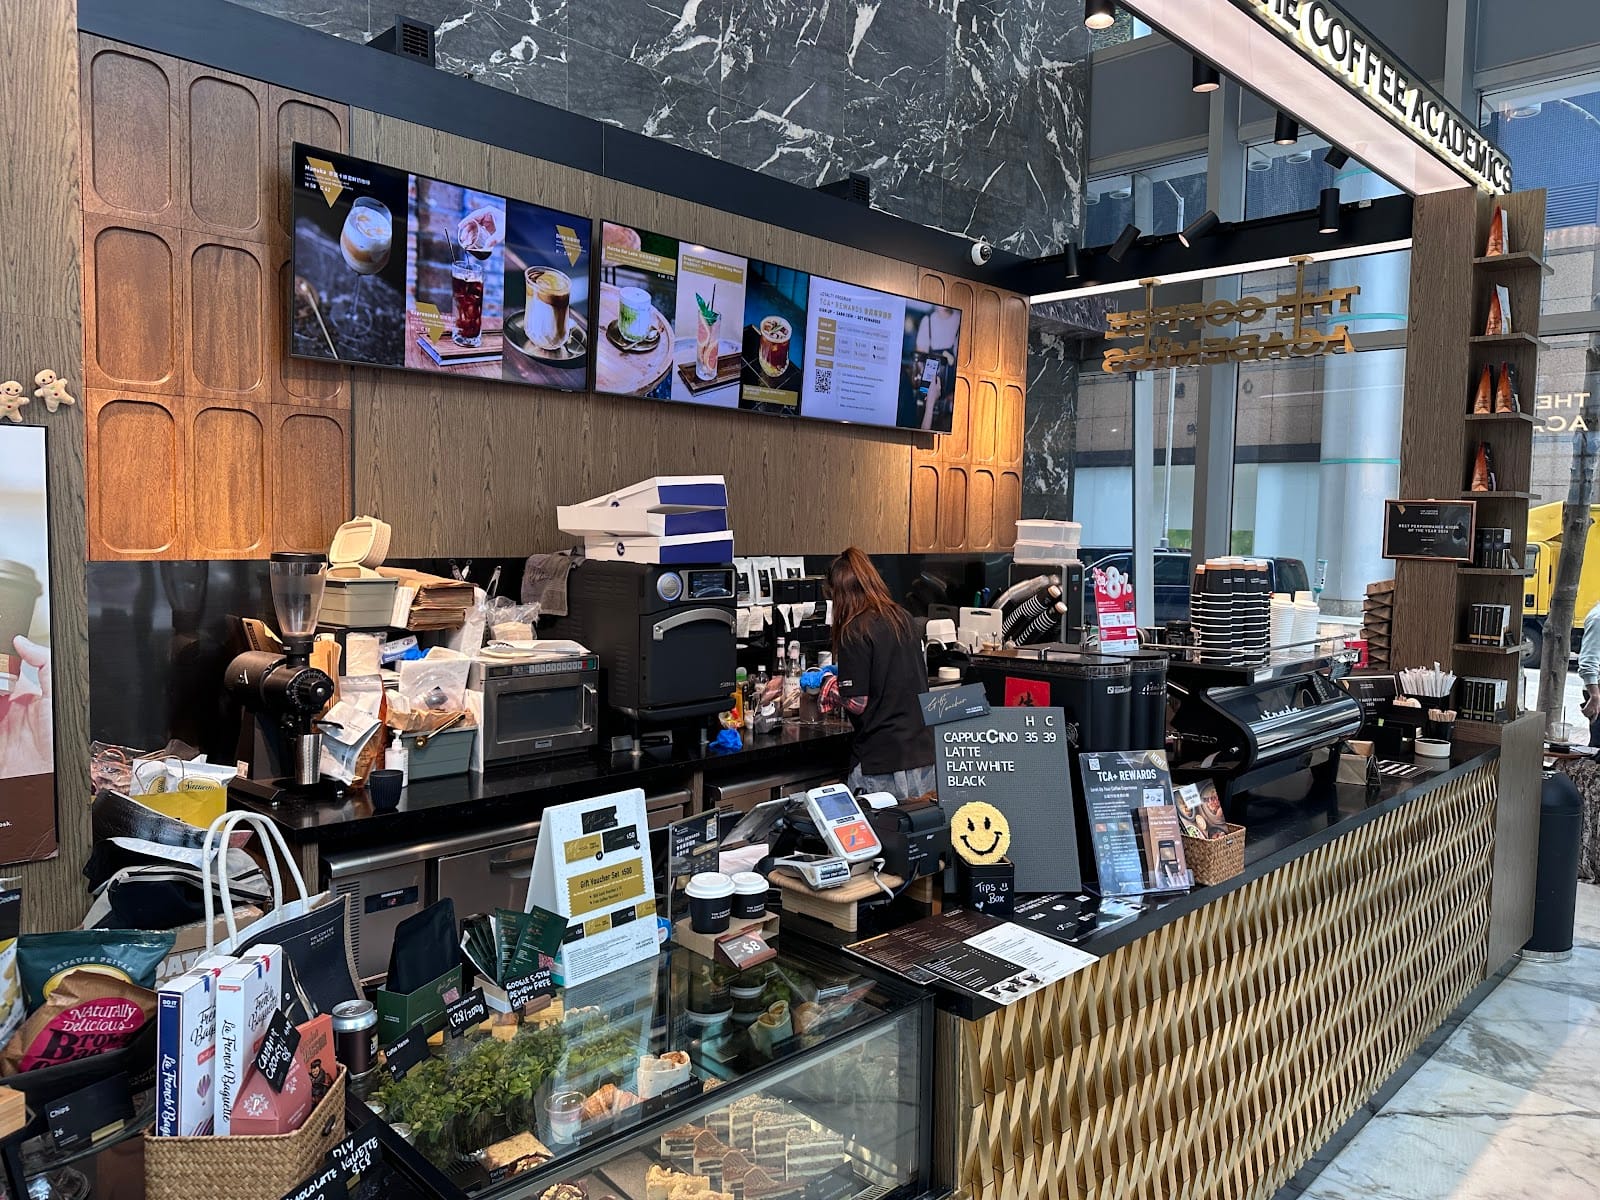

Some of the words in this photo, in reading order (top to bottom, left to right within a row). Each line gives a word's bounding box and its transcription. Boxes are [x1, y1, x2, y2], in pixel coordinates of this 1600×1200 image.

[1308, 1, 1409, 116] COFFEE
[1260, 705, 1302, 721] strada
[1025, 715, 1035, 727] H
[1045, 715, 1054, 727] C
[943, 729, 1019, 744] CAPPUCCINO
[1024, 731, 1039, 743] 35
[1042, 731, 1057, 743] 39
[945, 746, 981, 757] LATTE
[946, 761, 974, 772] FLAT
[975, 761, 1015, 772] WHITE
[947, 775, 987, 787] BLACK
[1096, 771, 1118, 782] TCA+
[1119, 769, 1157, 781] REWARDS
[580, 880, 590, 889] Gift
[590, 874, 611, 886] Voucher
[611, 871, 620, 879] Set
[974, 881, 996, 894] Tips
[986, 892, 1005, 904] Box
[506, 976, 530, 990] GOOGLE
[508, 985, 533, 1000] REVIEW
[197, 1003, 216, 1025] Fre
[223, 1035, 237, 1072] French
[219, 1072, 236, 1123] Baguette
[49, 1105, 71, 1119] Chips
[53, 1128, 64, 1138] 26
